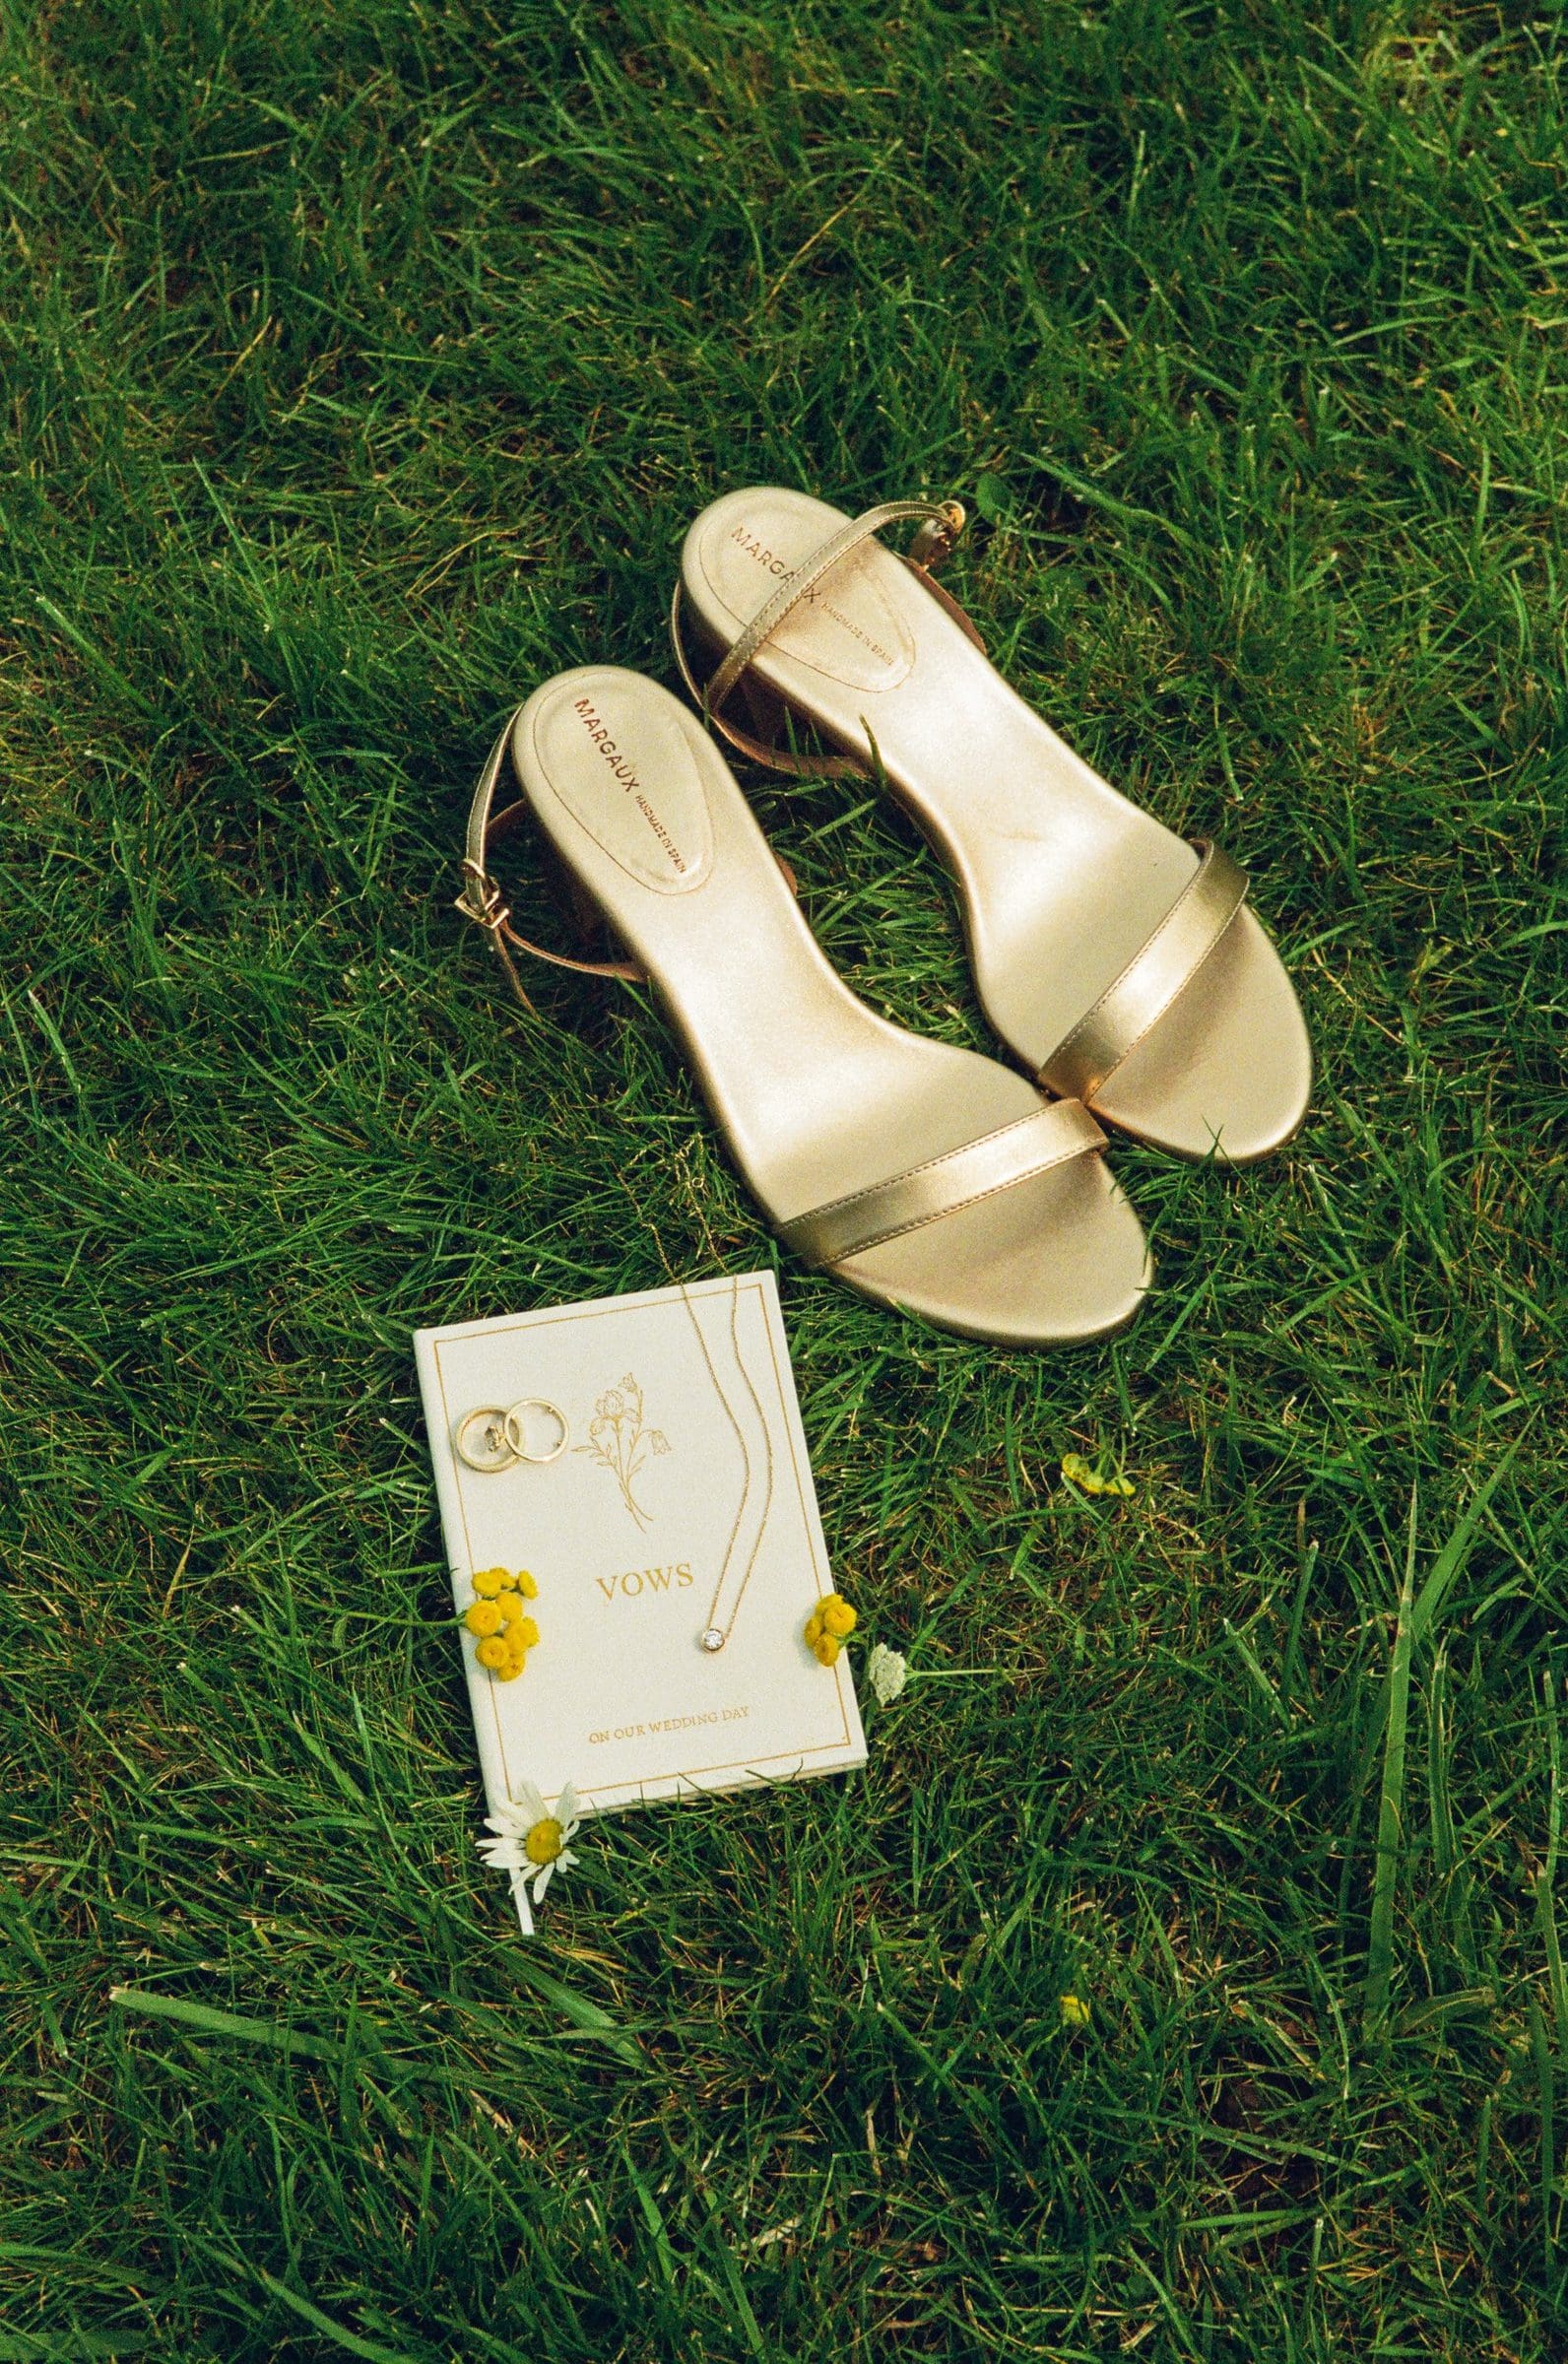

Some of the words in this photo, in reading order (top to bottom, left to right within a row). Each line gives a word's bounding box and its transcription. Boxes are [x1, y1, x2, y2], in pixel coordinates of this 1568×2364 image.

[731, 527, 821, 604] MARGAX
[574, 698, 640, 792] MARGAUX
[635, 794, 667, 839] HANDMADE
[662, 838, 673, 849] IN
[668, 848, 686, 873] SPAIN
[594, 1562, 694, 1601] VOWS
[589, 1731, 611, 1744] ON
[614, 1725, 646, 1740] OUR
[649, 1711, 718, 1734] WEDDING
[722, 1705, 750, 1722] DAY
